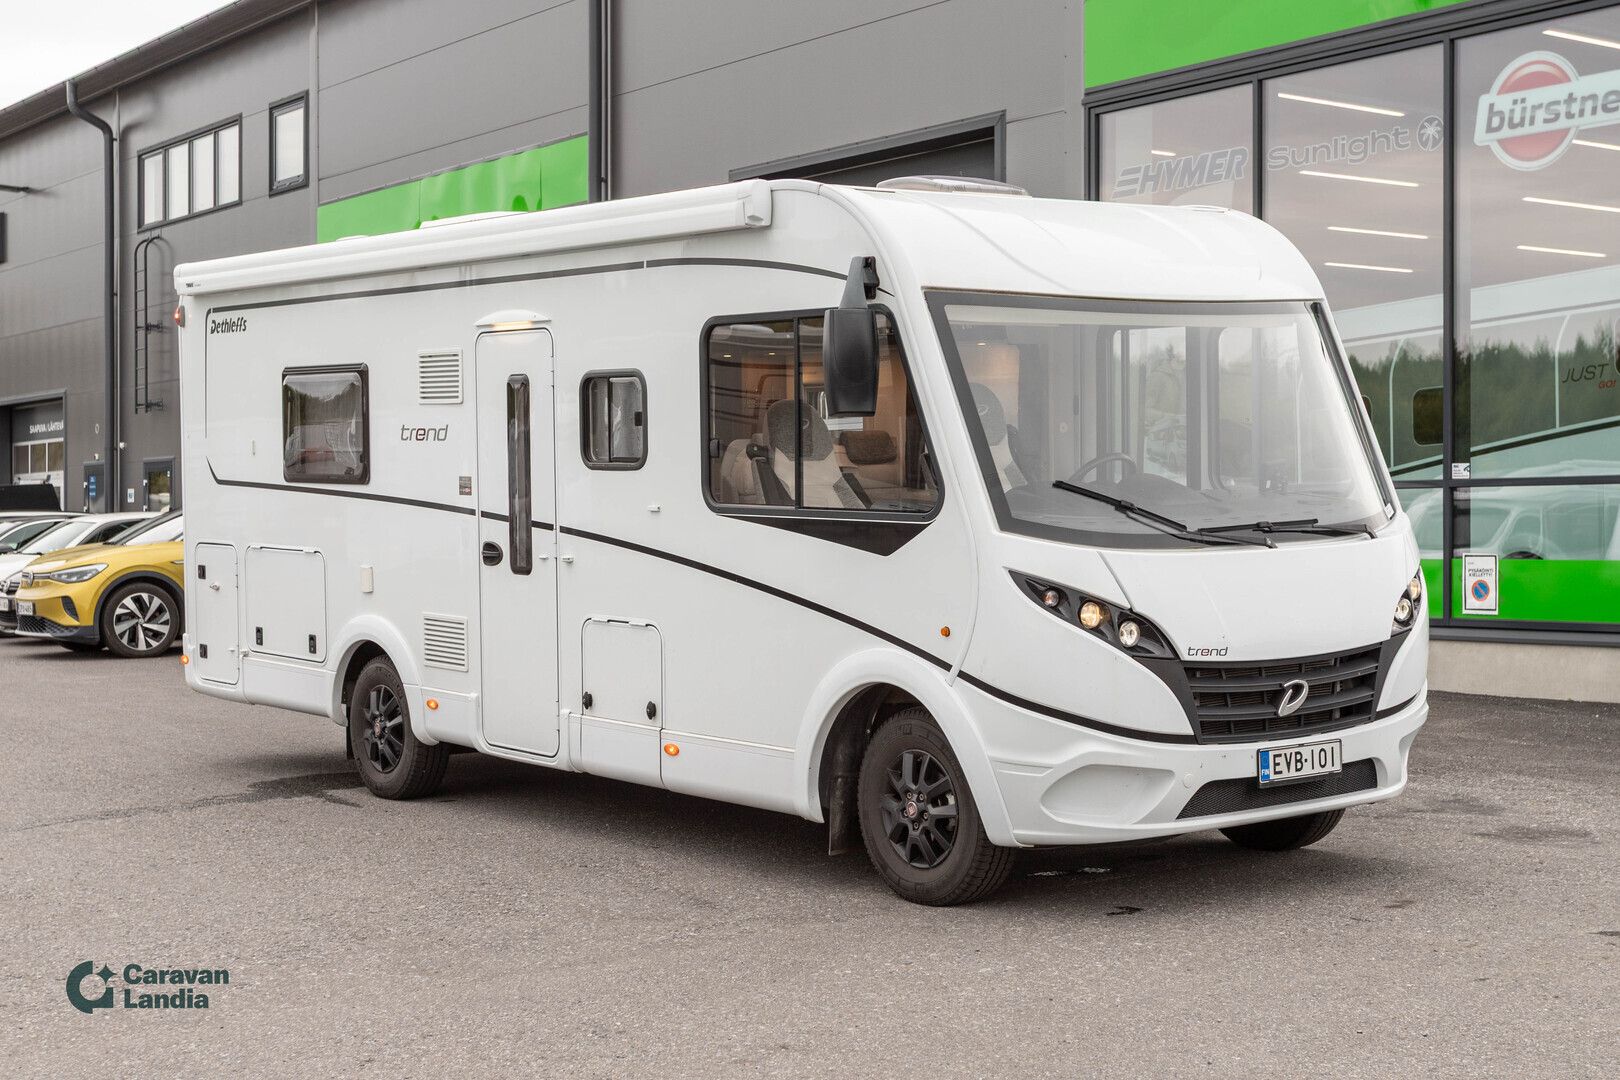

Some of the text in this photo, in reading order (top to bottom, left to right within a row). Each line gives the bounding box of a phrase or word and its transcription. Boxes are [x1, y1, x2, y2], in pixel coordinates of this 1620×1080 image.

[1267, 126, 1411, 171] Sunlight
[1138, 146, 1249, 195] HYMER
[210, 316, 247, 334] Dethleffs
[1562, 363, 1609, 383] JUST
[400, 424, 449, 441] trend
[1187, 646, 1228, 656] trend
